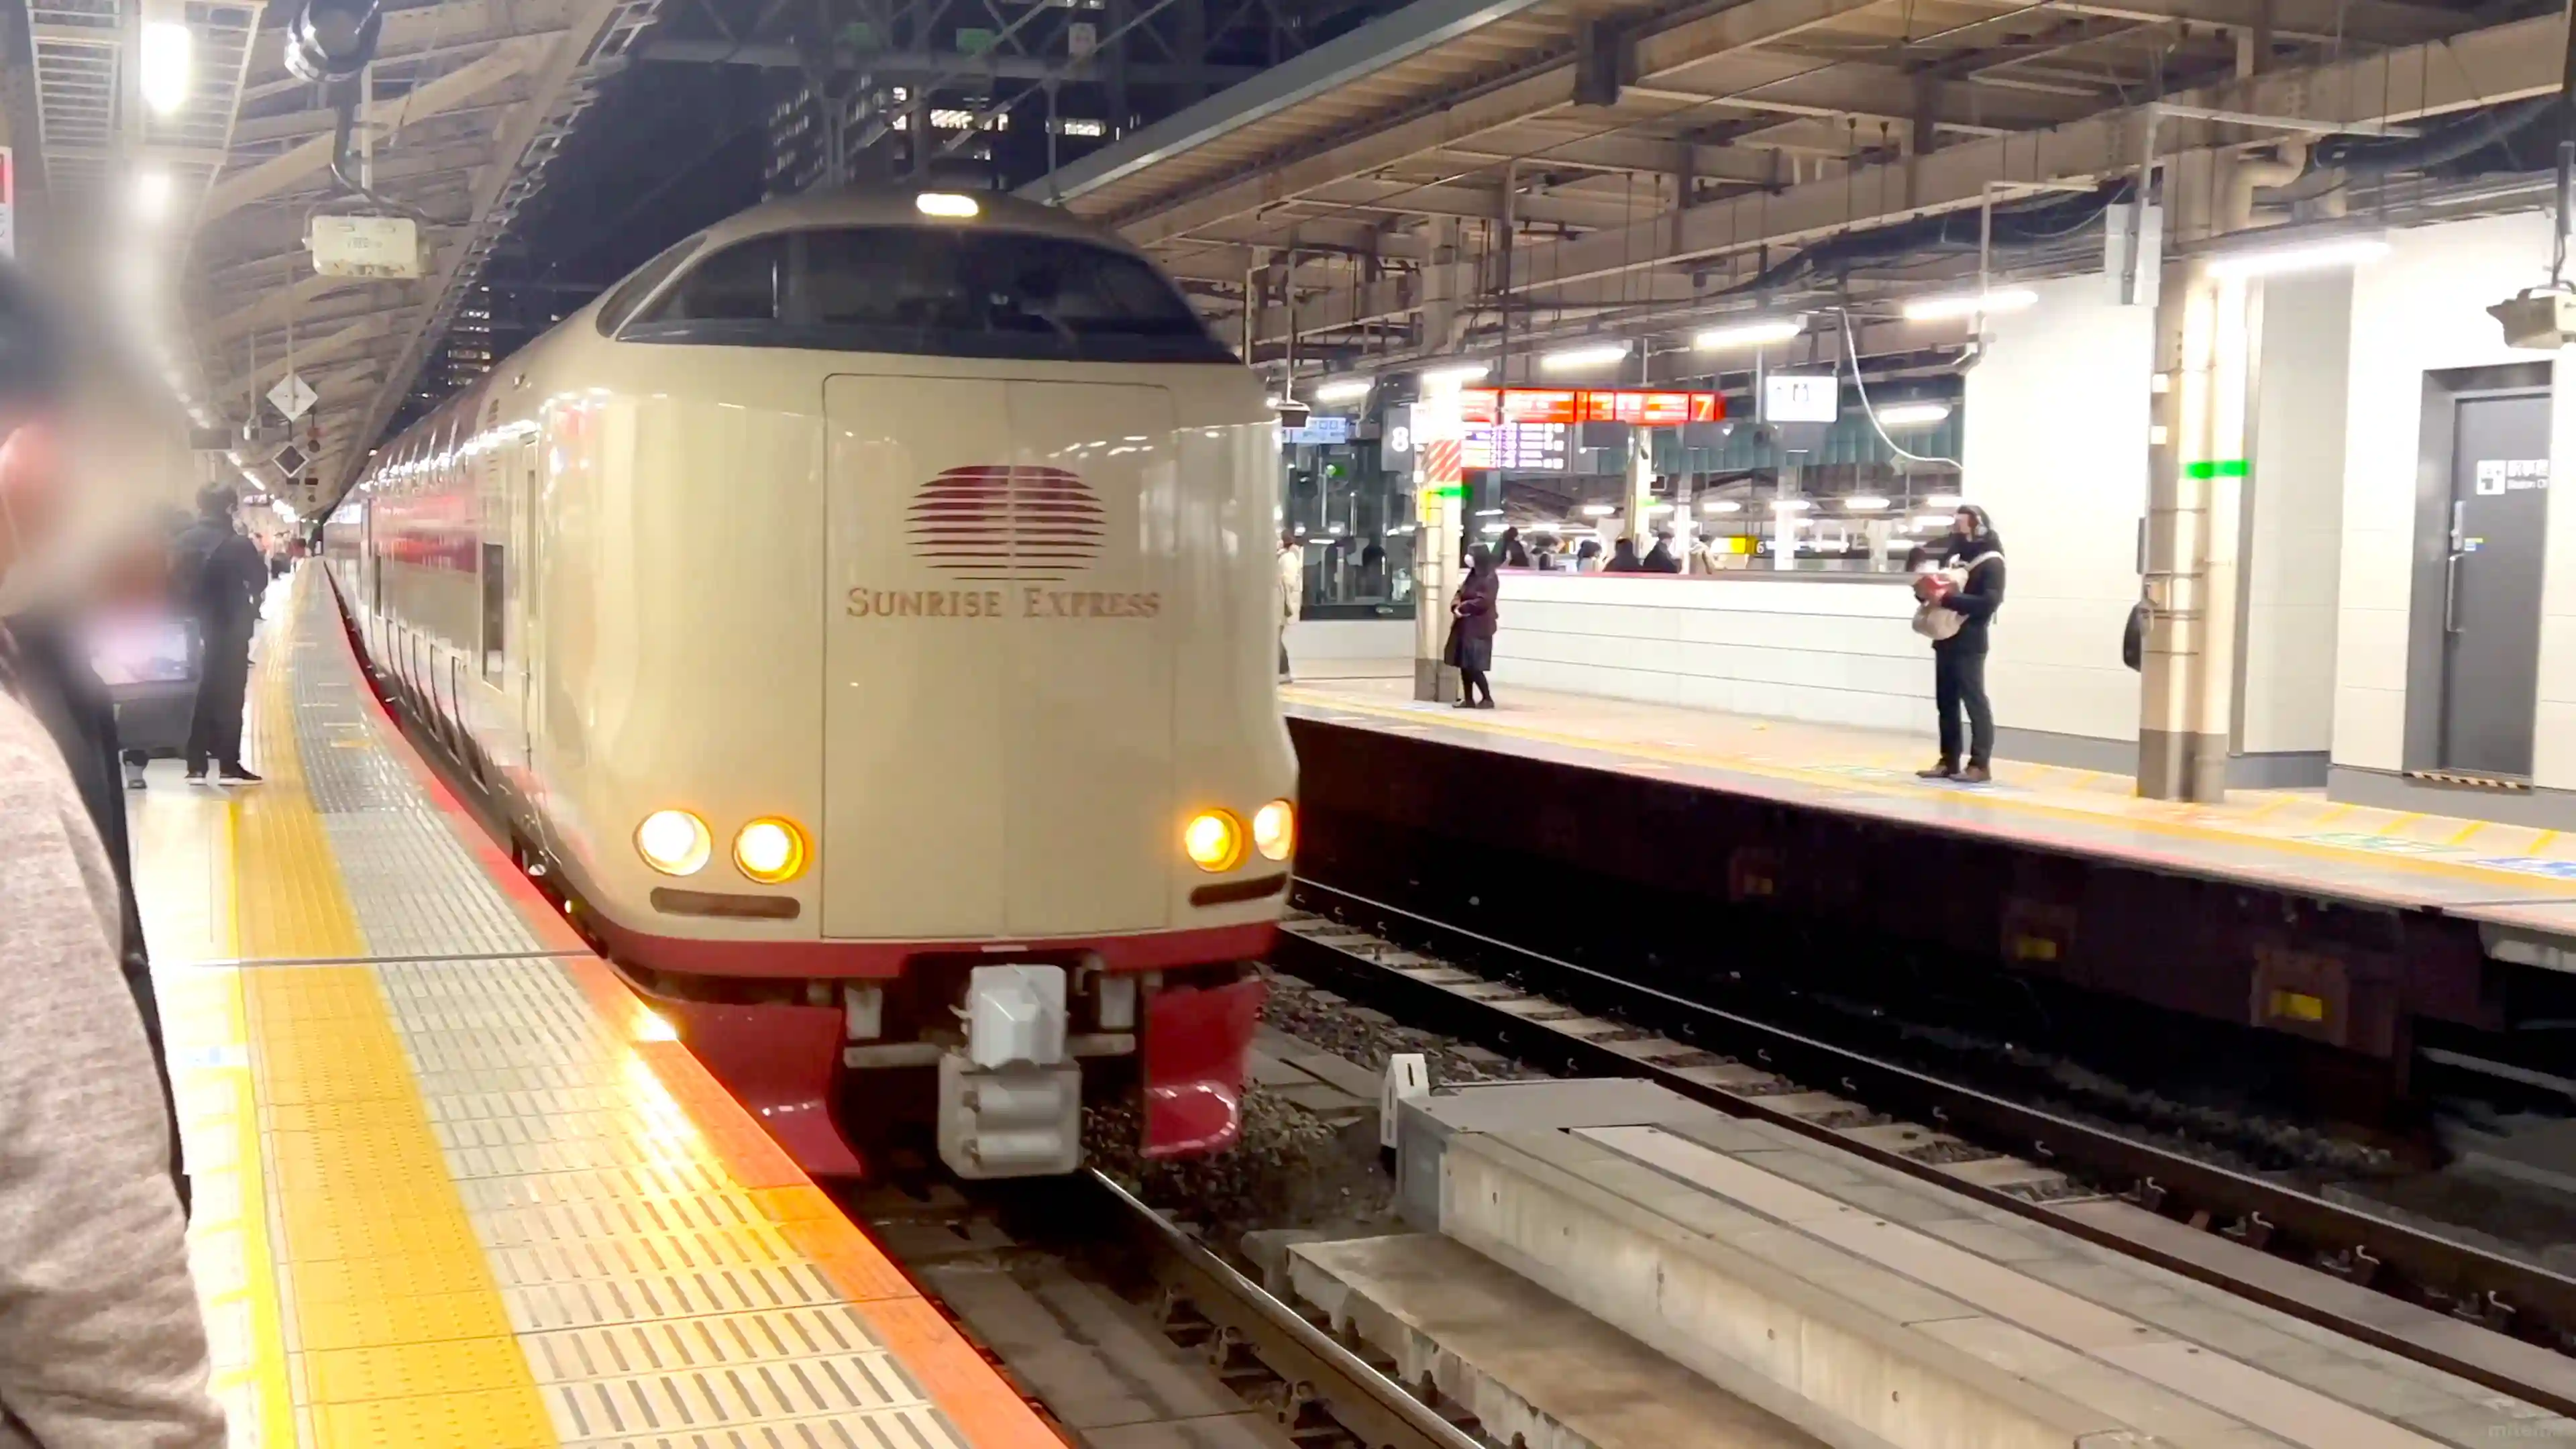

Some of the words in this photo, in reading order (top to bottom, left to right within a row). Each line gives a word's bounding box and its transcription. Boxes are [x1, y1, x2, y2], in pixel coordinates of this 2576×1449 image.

[1695, 396, 1712, 421] 7
[1391, 426, 1409, 452] 8
[1756, 540, 1765, 554] 6
[846, 587, 1002, 618] SUNRISE
[1022, 587, 1161, 618] EXPRESS
